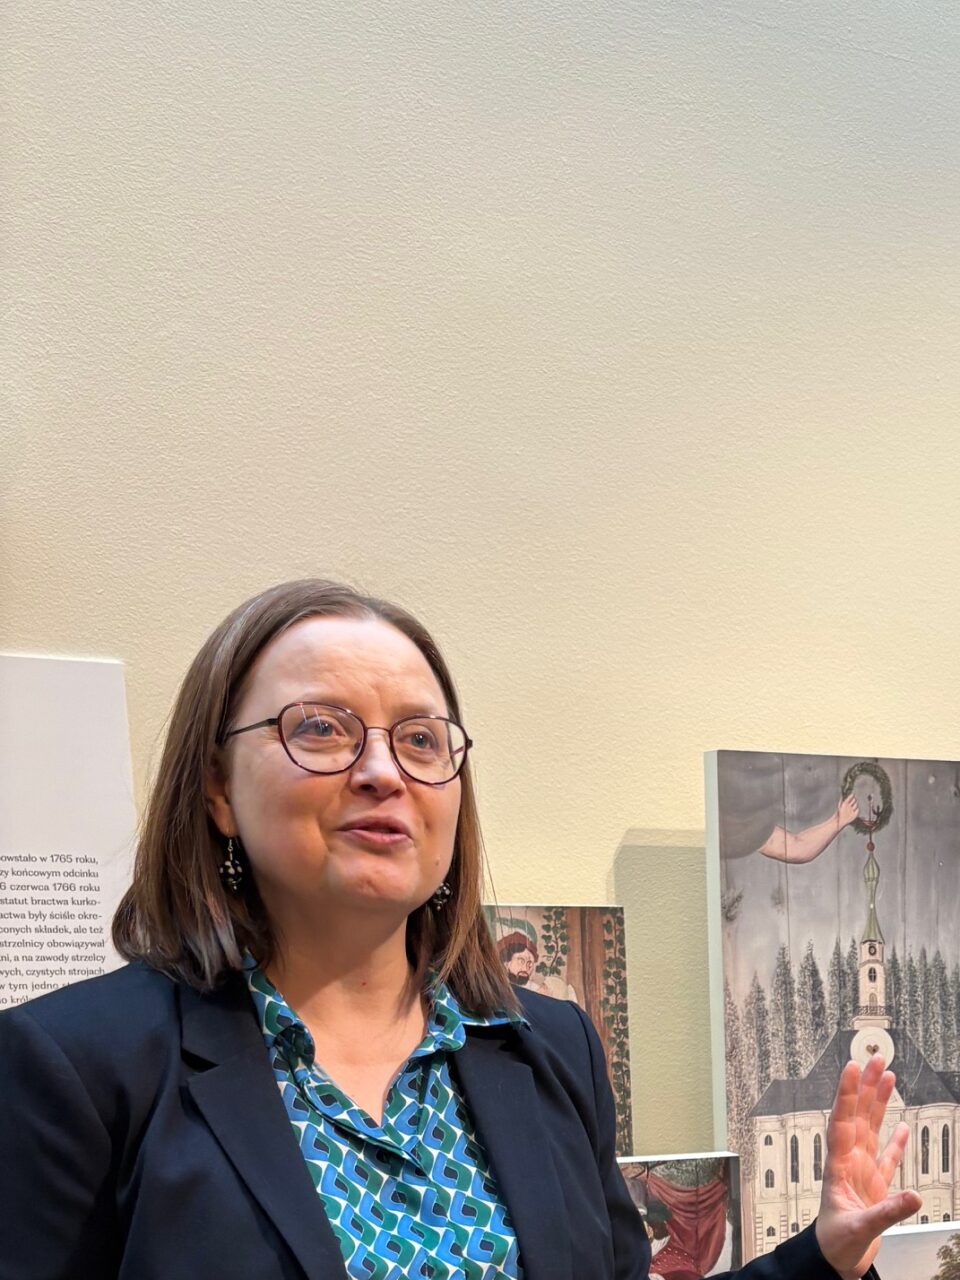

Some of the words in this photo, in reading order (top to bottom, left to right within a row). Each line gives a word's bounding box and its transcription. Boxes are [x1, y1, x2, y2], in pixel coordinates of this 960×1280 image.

[0, 853, 37, 863] owstało
[40, 855, 48, 863] w
[50, 854, 73, 863] 1765
[75, 855, 98, 865] roku,
[11, 868, 61, 879] końcowym
[63, 869, 99, 878] odcinku
[52, 883, 76, 892] 1766
[79, 883, 101, 892] roku
[0, 897, 29, 905] statut
[31, 896, 69, 905] bractwa
[71, 897, 101, 905] kurko-
[28, 910, 47, 922] były
[49, 911, 76, 920] ściśle
[77, 911, 103, 920] okre-
[34, 925, 72, 934] składek,
[73, 925, 87, 934] ale
[89, 926, 104, 934] też
[13, 954, 20, 962] a
[21, 954, 33, 962] na
[35, 953, 69, 964] zawody
[71, 953, 106, 964] strzelcy
[25, 967, 66, 978] czystych
[9, 982, 28, 992] tym
